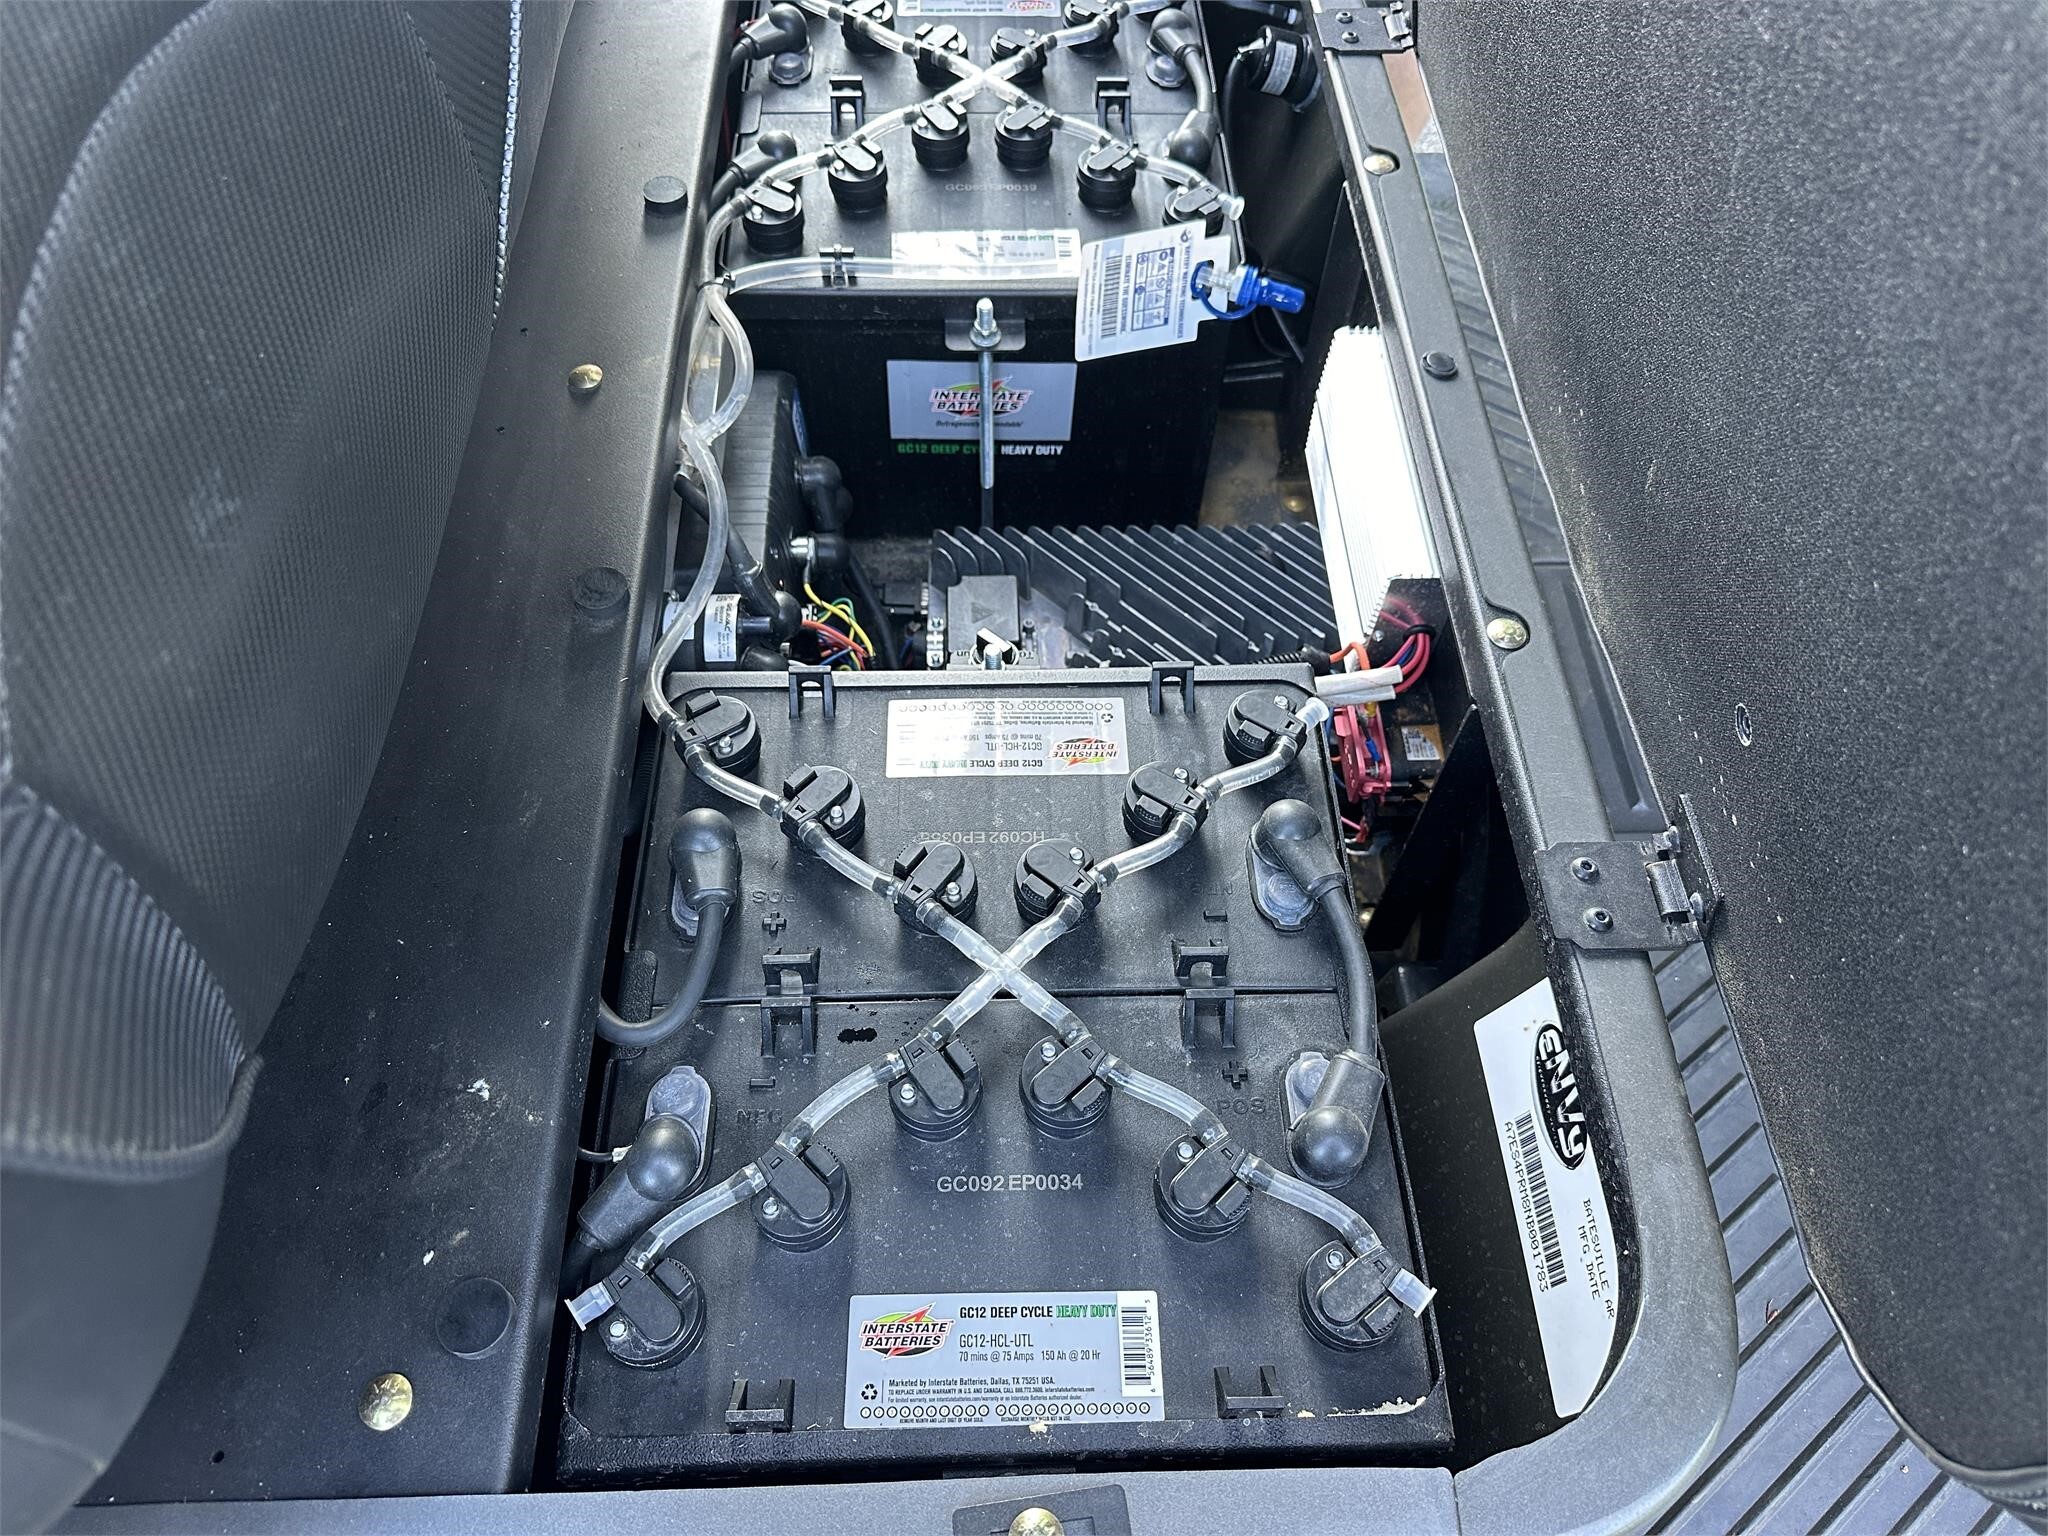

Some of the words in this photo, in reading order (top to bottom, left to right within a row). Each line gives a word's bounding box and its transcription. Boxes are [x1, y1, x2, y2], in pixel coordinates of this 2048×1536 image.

[934, 391, 1025, 401] INTERTATE
[937, 402, 1018, 411] BATTEIES
[931, 444, 960, 454] DEEP
[1001, 445, 1033, 455] HEAVY
[1035, 445, 1063, 455] DUTY
[969, 760, 995, 768] CYCLE
[1022, 760, 1043, 768] GC12
[1216, 1096, 1266, 1115] POS
[936, 1175, 1005, 1193] GC092
[1008, 1173, 1084, 1191] EP0034
[1577, 1225, 1591, 1254] MFG
[1586, 1263, 1601, 1301] DATE
[1583, 1198, 1610, 1292] BATESVILLE
[1604, 1299, 1615, 1319] AR
[959, 1306, 986, 1319] GC12
[990, 1306, 1018, 1318] DEEP
[1020, 1306, 1053, 1318] CYCLE
[1055, 1304, 1088, 1318] HEAVY
[1090, 1303, 1117, 1318] DUTY
[862, 1322, 947, 1334] INTERSTATE
[864, 1335, 941, 1347] BATTERIES
[959, 1333, 1034, 1348] GC12-HCL-UTL
[959, 1351, 969, 1362] 70
[970, 1351, 988, 1361] mins
[990, 1351, 1001, 1363] @
[1002, 1350, 1012, 1361] 75
[1013, 1350, 1034, 1363] Amps
[1041, 1350, 1055, 1361] 150
[1056, 1350, 1067, 1360] Ah
[1068, 1350, 1079, 1362] @
[1080, 1349, 1091, 1360] 20
[1092, 1349, 1101, 1360] Hr
[888, 1379, 918, 1387] Marketed
[919, 1379, 927, 1388] by
[928, 1378, 958, 1386] Interstate
[959, 1377, 989, 1386] Batteries,
[990, 1377, 1011, 1386] Dallas,
[1012, 1377, 1020, 1385] TX
[1021, 1377, 1039, 1385] 75251
[1041, 1376, 1055, 1385] USA.
